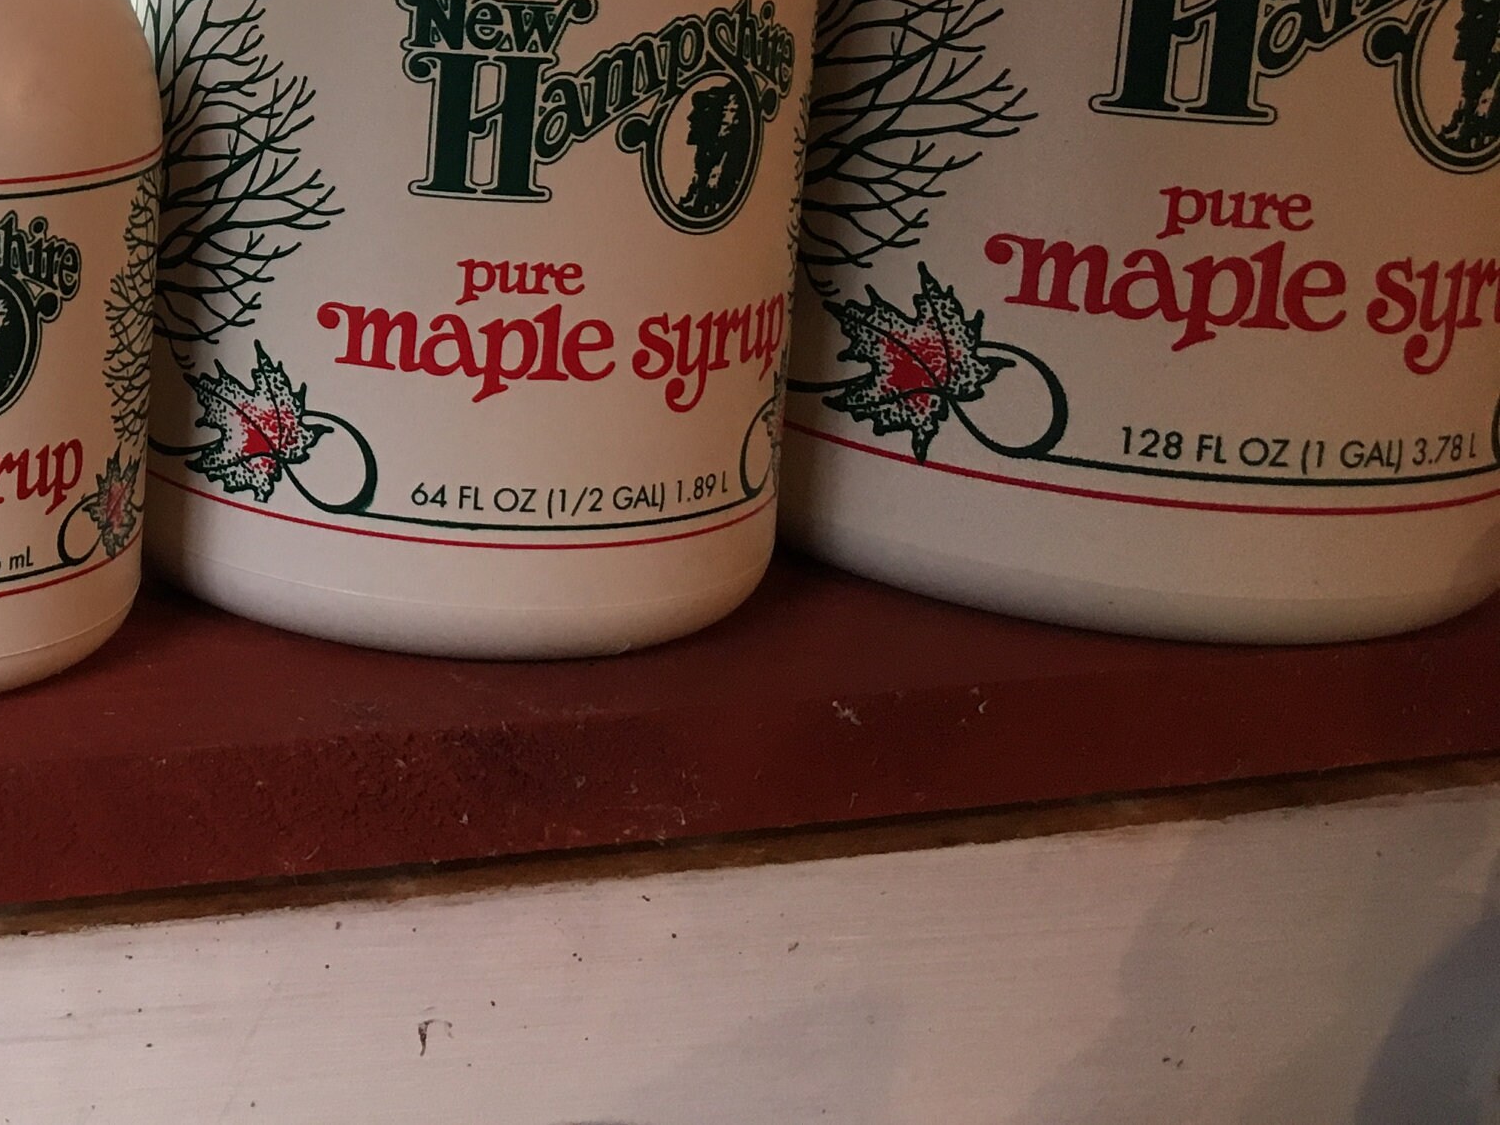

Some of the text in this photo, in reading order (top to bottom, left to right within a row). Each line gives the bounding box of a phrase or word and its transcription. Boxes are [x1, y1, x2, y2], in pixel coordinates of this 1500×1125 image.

[1156, 185, 1315, 239] pure
[455, 257, 585, 305] pure
[984, 232, 1500, 375] maple syr
[316, 292, 785, 413] maple syrup
[1120, 426, 1182, 460] 128
[1196, 434, 1226, 465] FL
[1240, 438, 1288, 467] OZ
[1301, 438, 1325, 474] (1
[1340, 439, 1403, 473] GAL)
[410, 482, 447, 509] 64
[459, 486, 484, 511] FL
[494, 487, 537, 513] OZ
[547, 486, 605, 519] (1/2
[613, 482, 666, 512] GAL)
